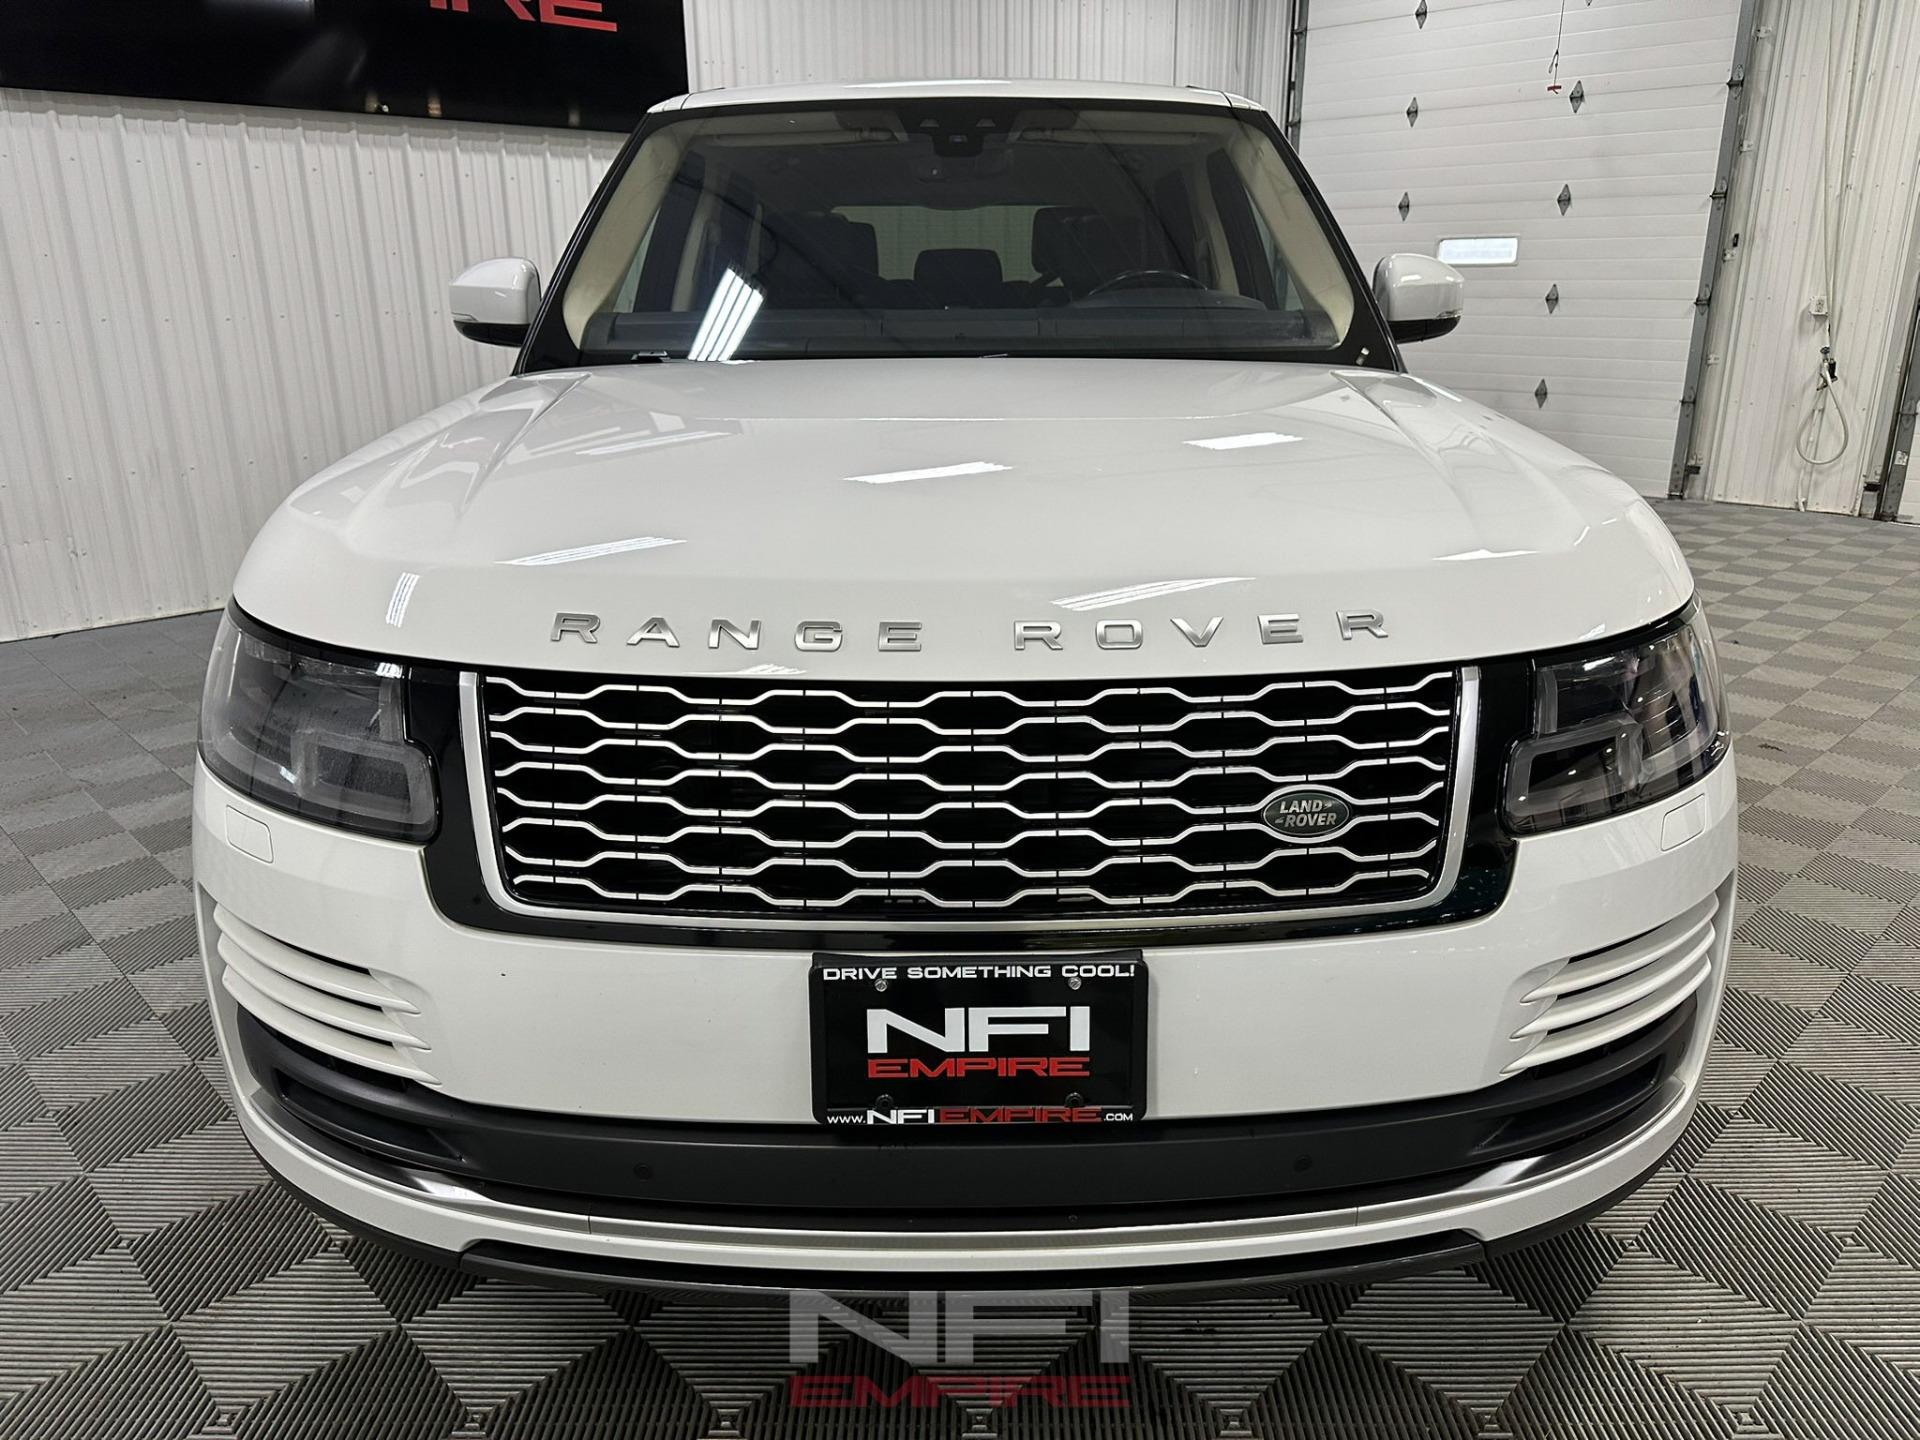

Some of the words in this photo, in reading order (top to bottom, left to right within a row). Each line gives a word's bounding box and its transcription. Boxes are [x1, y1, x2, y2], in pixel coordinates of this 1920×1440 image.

[550, 612, 923, 652] RANGE
[1013, 608, 1389, 651] ROVER
[1280, 799, 1323, 814] LAND
[1284, 812, 1337, 828] ROVER
[823, 967, 897, 980] DRIVE
[907, 965, 1051, 979] SOMETHING
[1061, 964, 1135, 978] COOL!
[866, 1006, 1091, 1054] NFI
[867, 1056, 1091, 1079] EMPIRE
